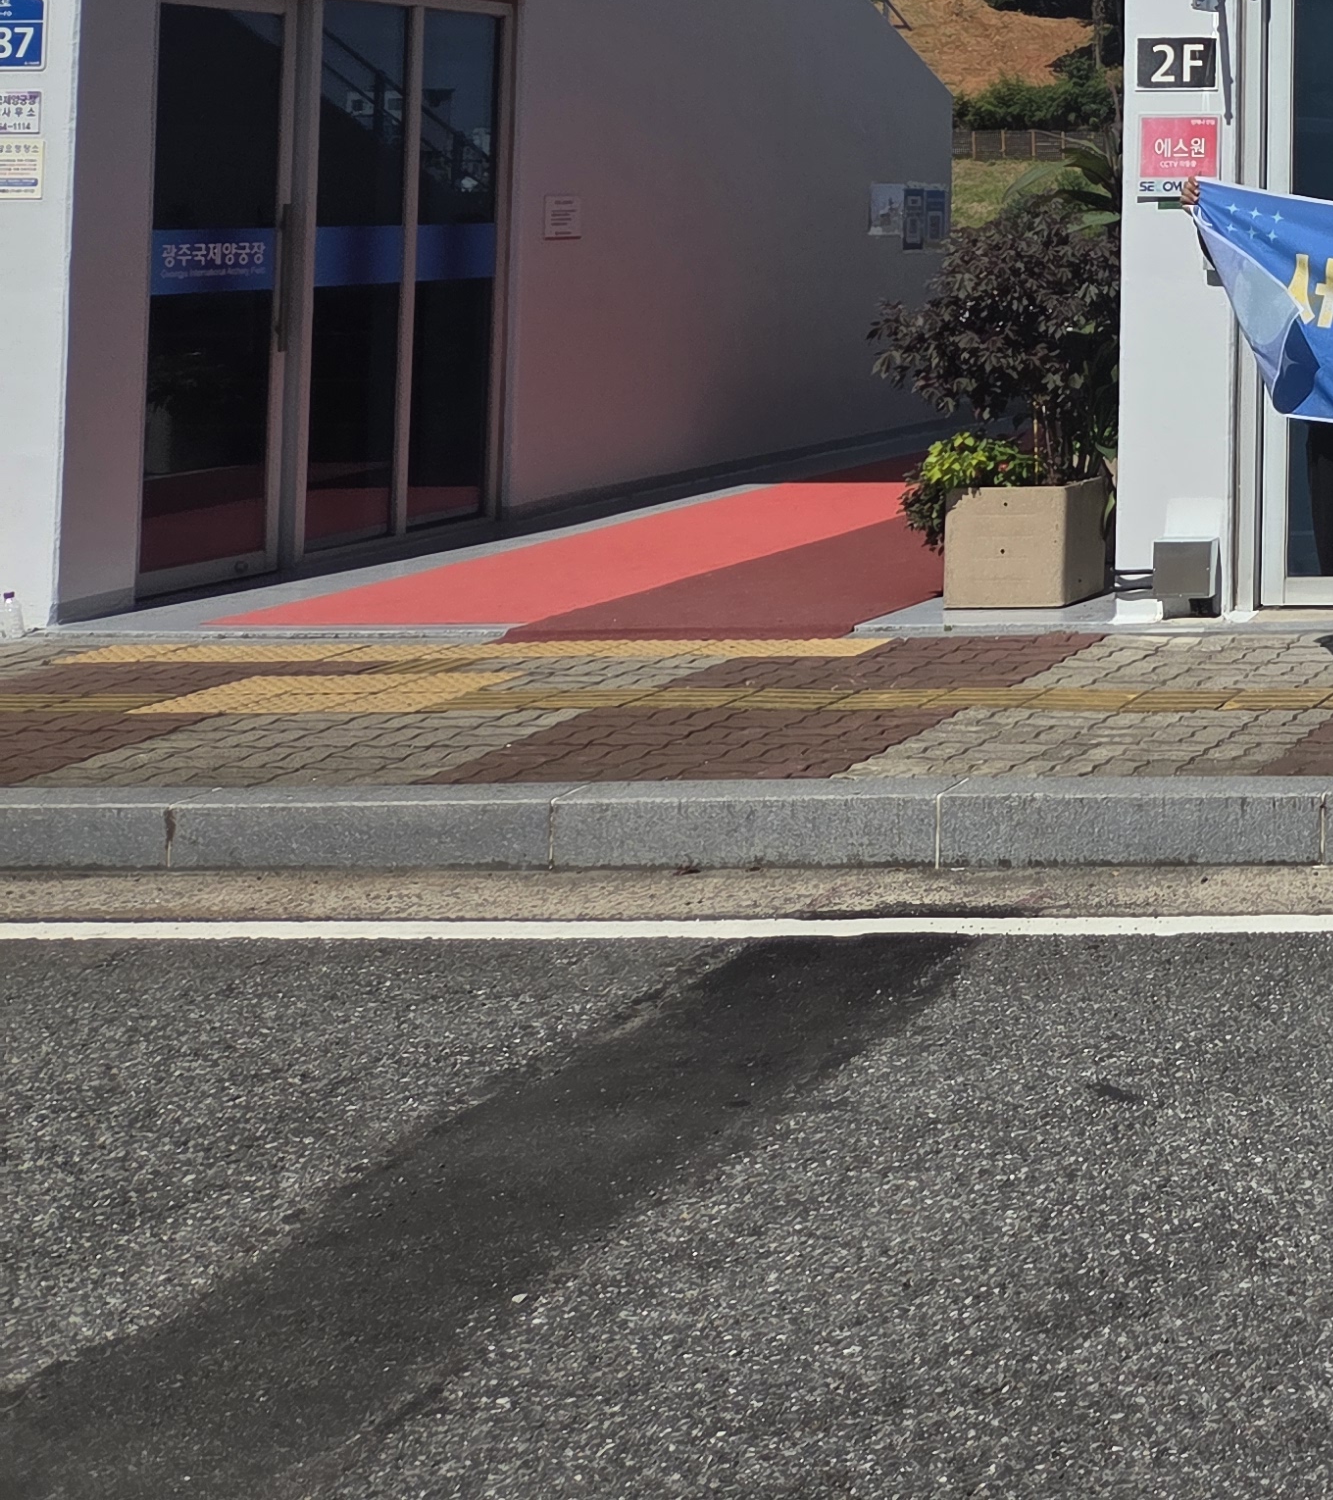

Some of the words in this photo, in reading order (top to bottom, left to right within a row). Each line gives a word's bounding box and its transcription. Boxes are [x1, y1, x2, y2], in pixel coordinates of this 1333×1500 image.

[1150, 43, 1205, 83] 2F
[0, 94, 38, 106] 제양궁장
[1154, 137, 1206, 158] 에스원
[161, 242, 266, 268] 광주국제양궁장
